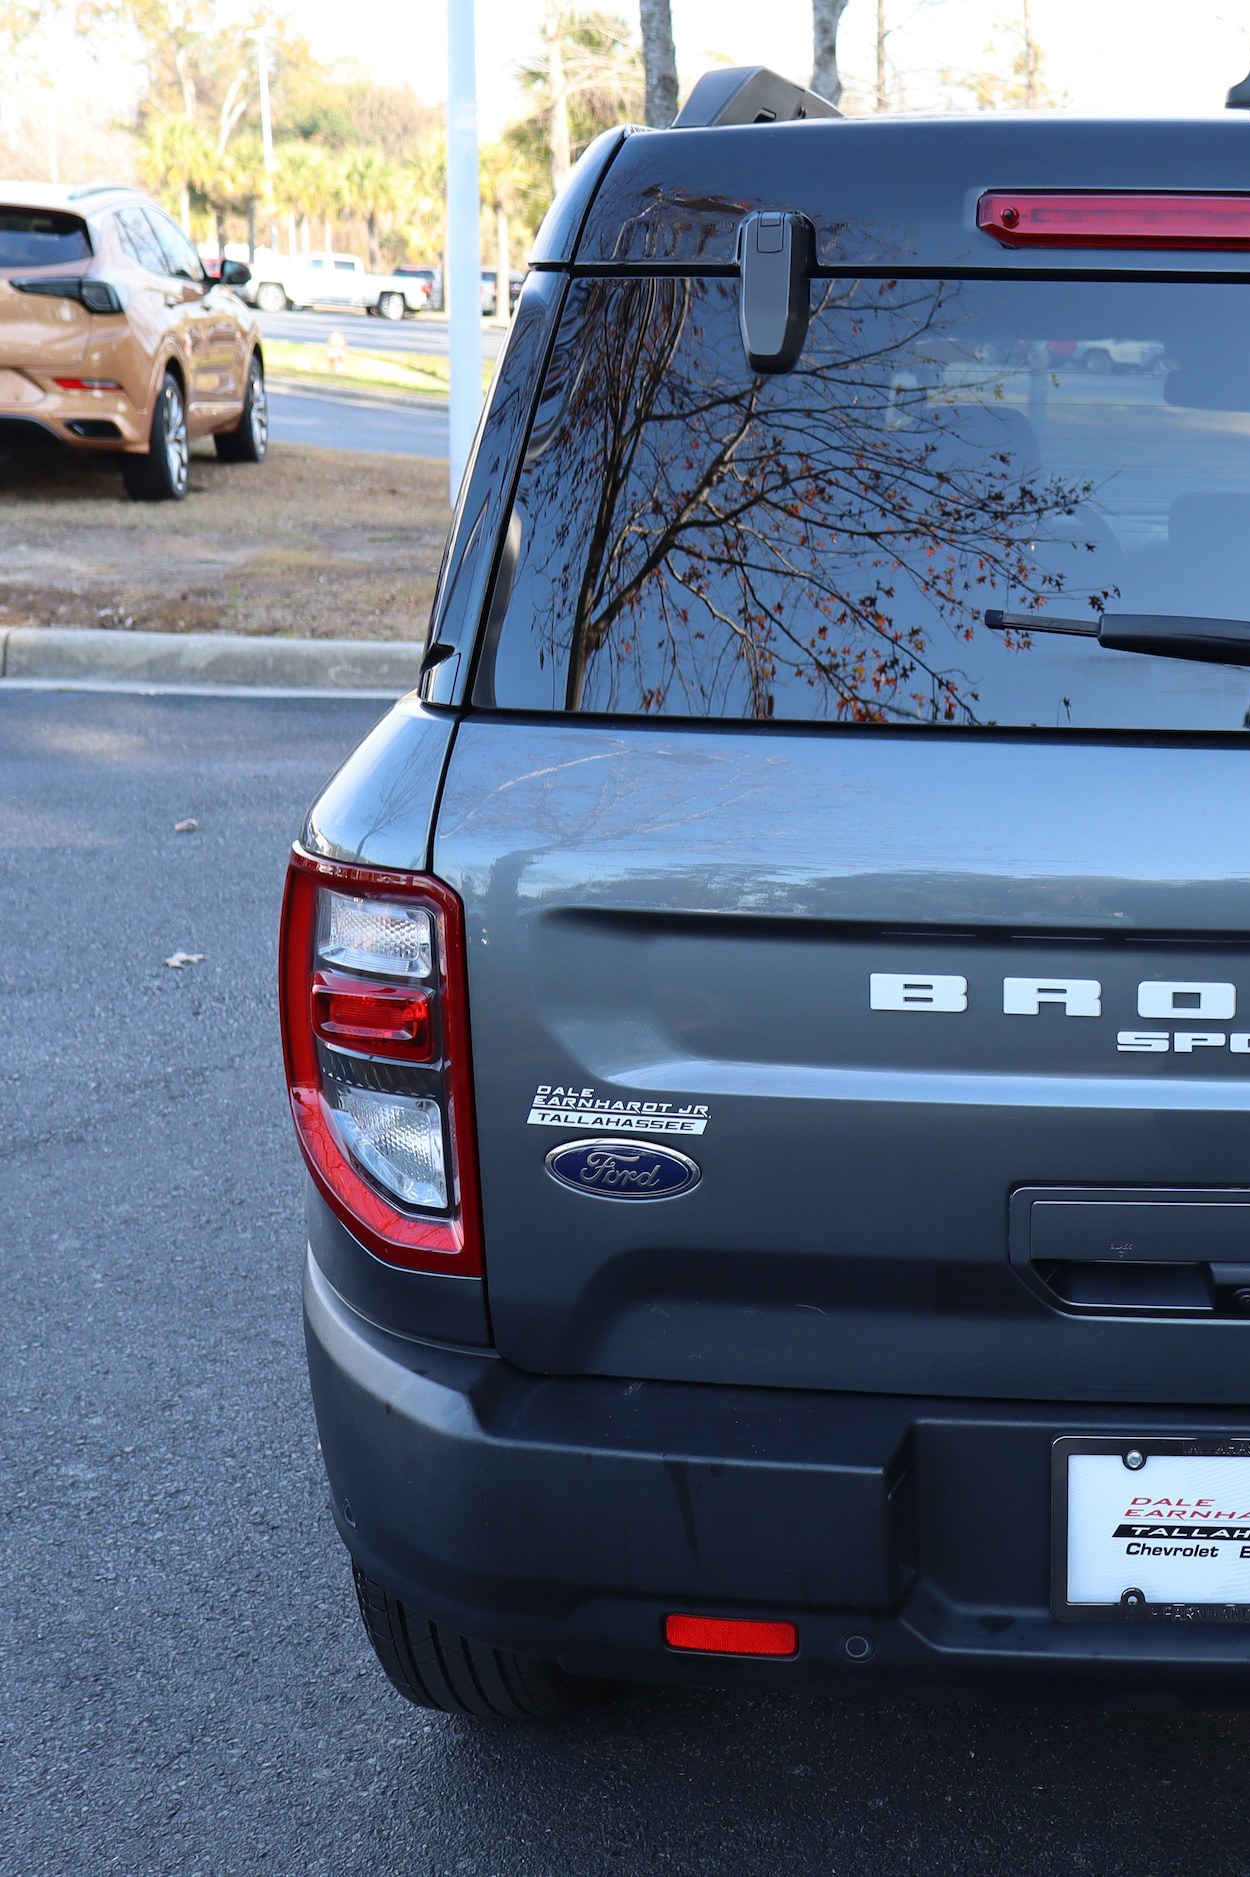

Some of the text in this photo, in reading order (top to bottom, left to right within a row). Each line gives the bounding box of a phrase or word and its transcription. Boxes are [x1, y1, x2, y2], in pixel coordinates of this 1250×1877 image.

[536, 1085, 594, 1097] DALE
[532, 1095, 672, 1114] EARNHARDT
[537, 1112, 696, 1131] TALLAHASSEE
[579, 1151, 662, 1187] Ford
[1130, 1497, 1216, 1507] DALE
[1125, 1542, 1220, 1558] Chevrolet
